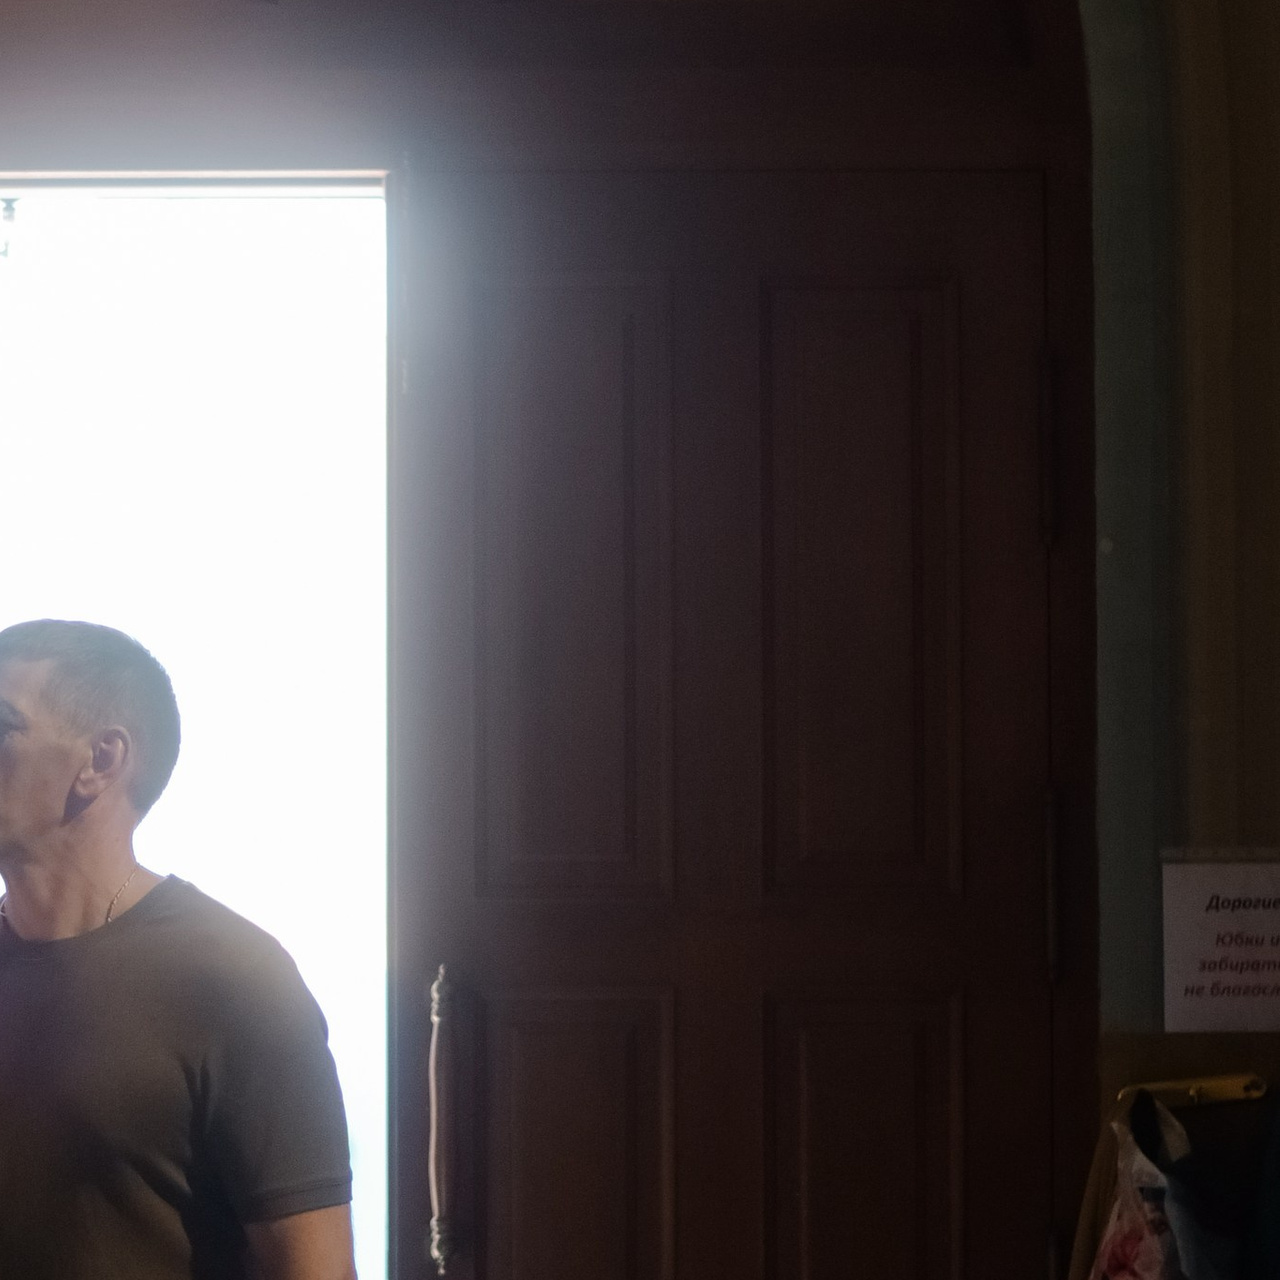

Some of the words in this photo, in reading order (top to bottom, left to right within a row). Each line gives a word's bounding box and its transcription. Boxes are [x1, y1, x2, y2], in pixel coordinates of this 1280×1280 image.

[1205, 894, 1280, 912] Дорогие
[1215, 931, 1265, 947] Юбки
[1184, 984, 1205, 998] не
